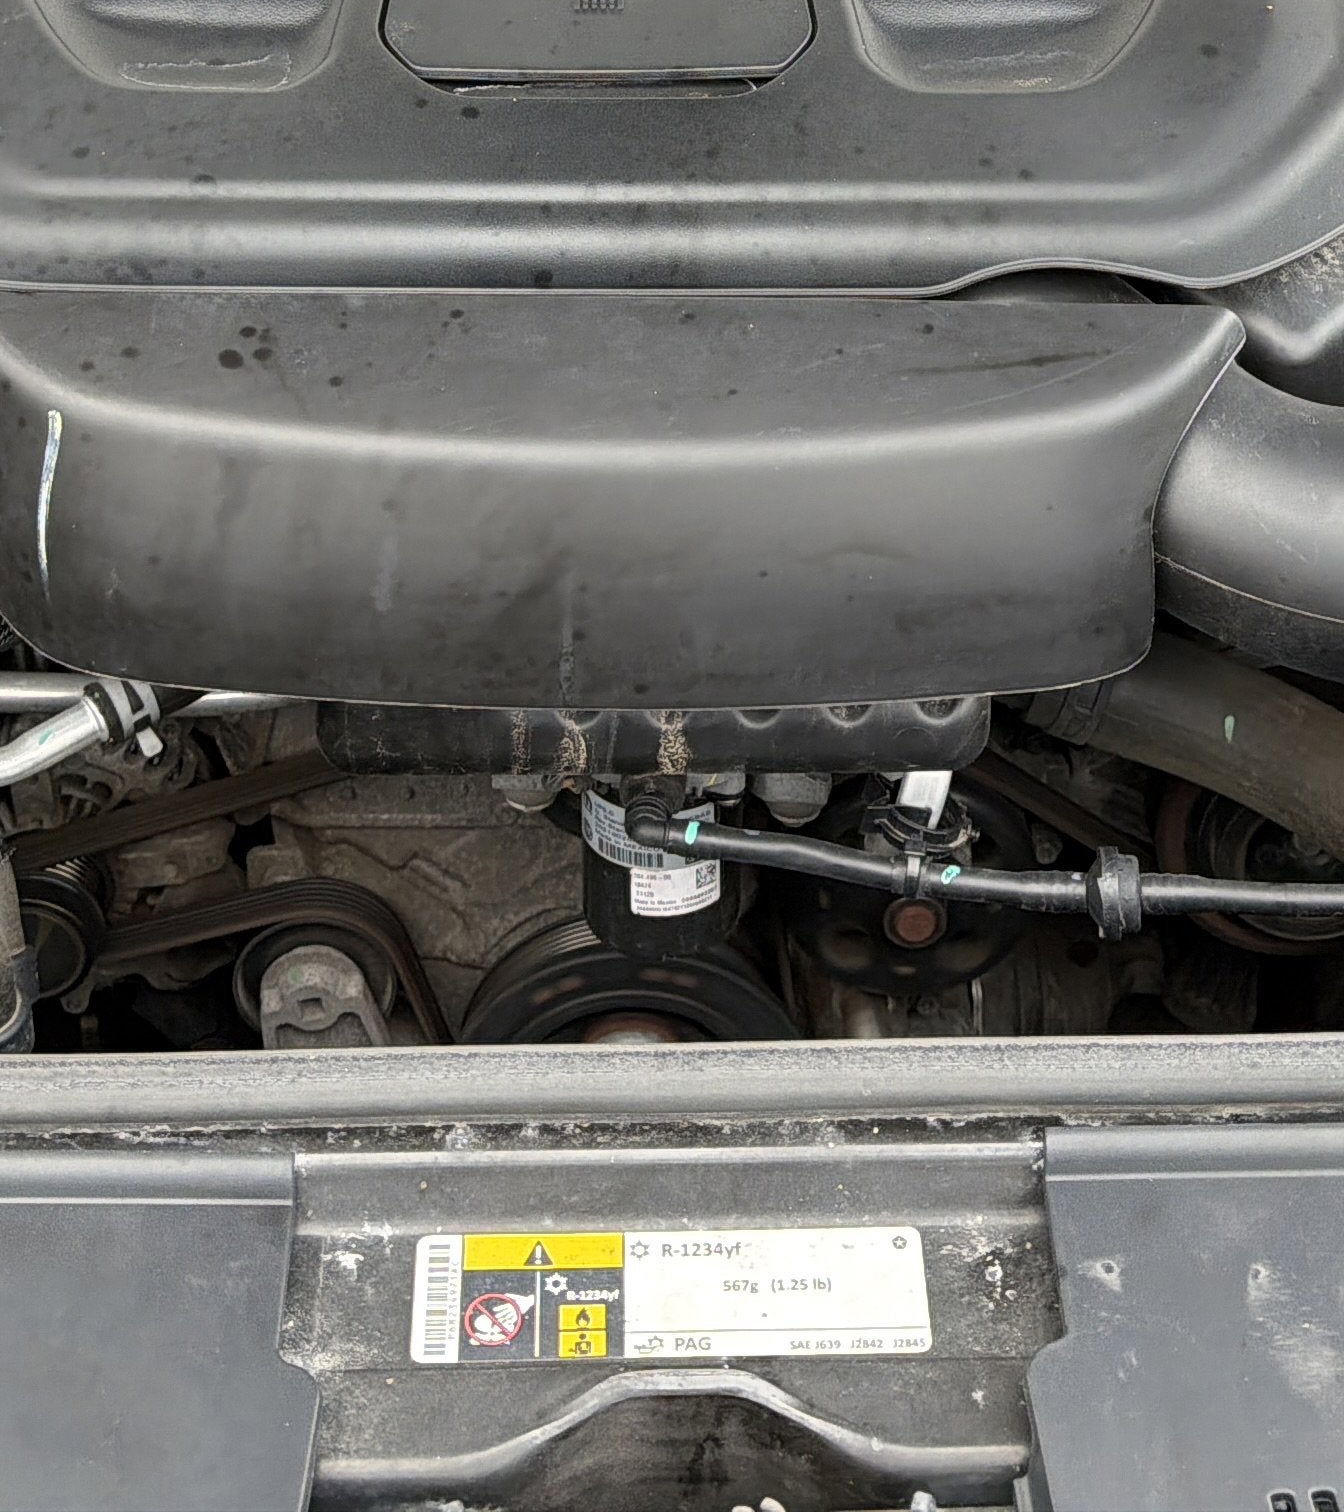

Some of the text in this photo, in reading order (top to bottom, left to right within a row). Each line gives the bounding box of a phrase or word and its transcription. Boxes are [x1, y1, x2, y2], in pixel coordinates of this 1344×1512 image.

[661, 1241, 742, 1260] R-1234yf
[722, 1277, 832, 1294] 567g (1.25 lb)
[566, 1288, 621, 1302] R-1234yf
[674, 1336, 712, 1352] PAG
[790, 1339, 811, 1350] SAE
